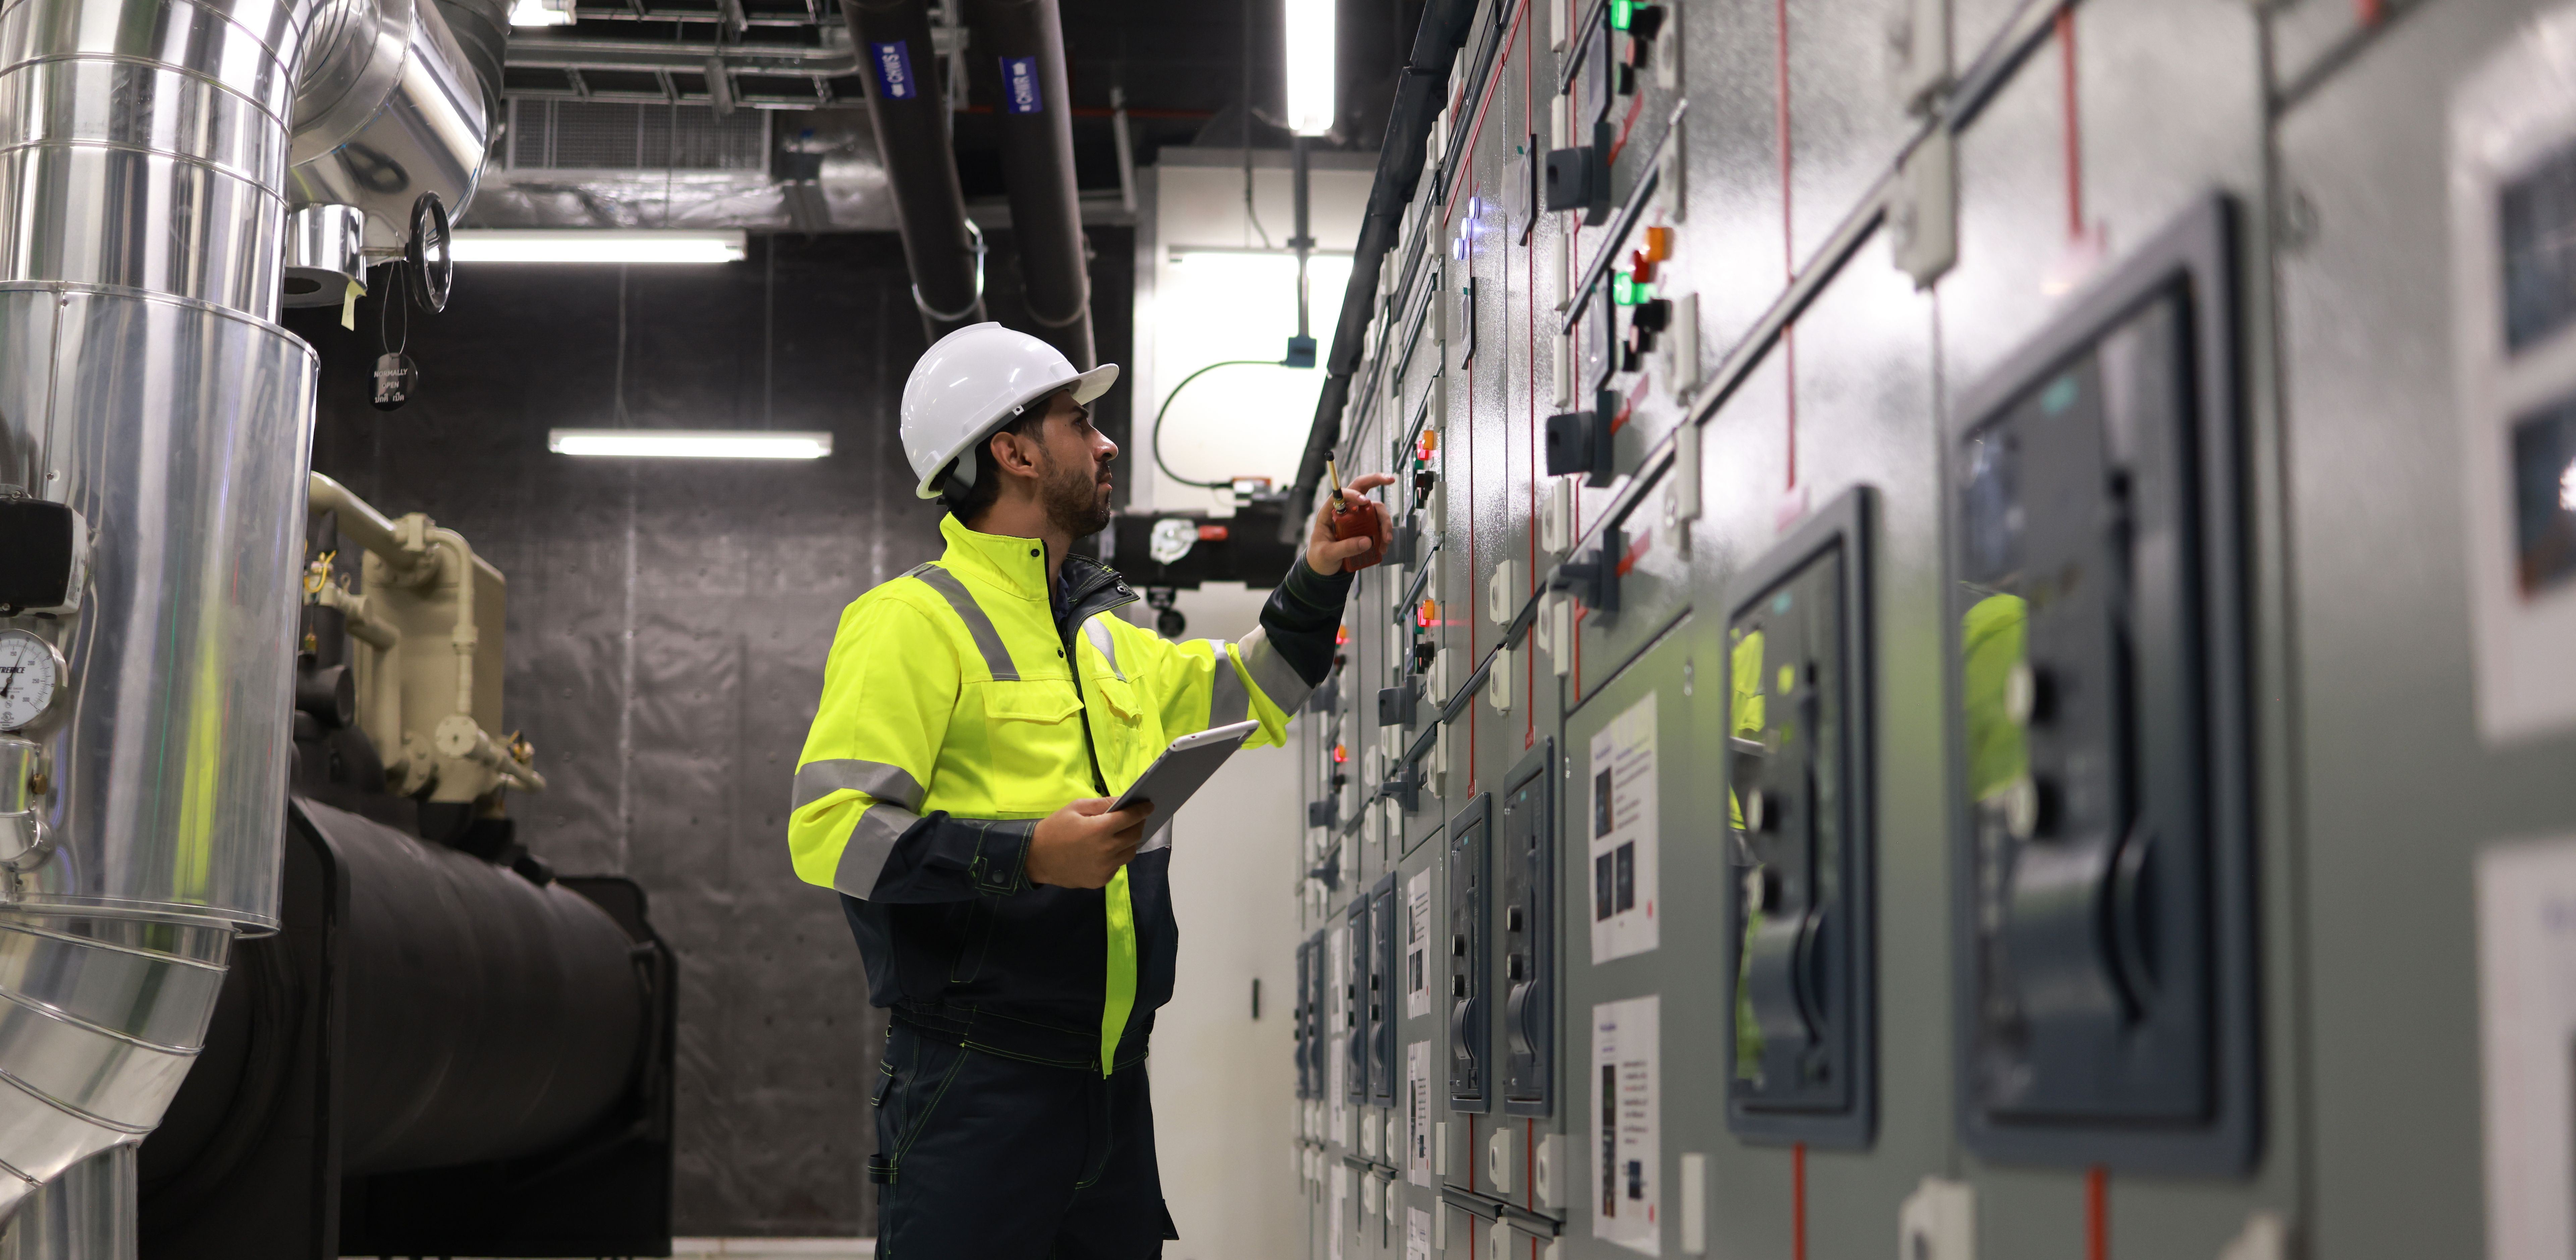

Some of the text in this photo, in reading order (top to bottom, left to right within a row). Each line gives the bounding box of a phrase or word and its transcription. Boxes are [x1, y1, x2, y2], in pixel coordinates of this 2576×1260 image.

[374, 368, 408, 378] NORMALLY
[374, 391, 405, 403] ปกติ เปิด
